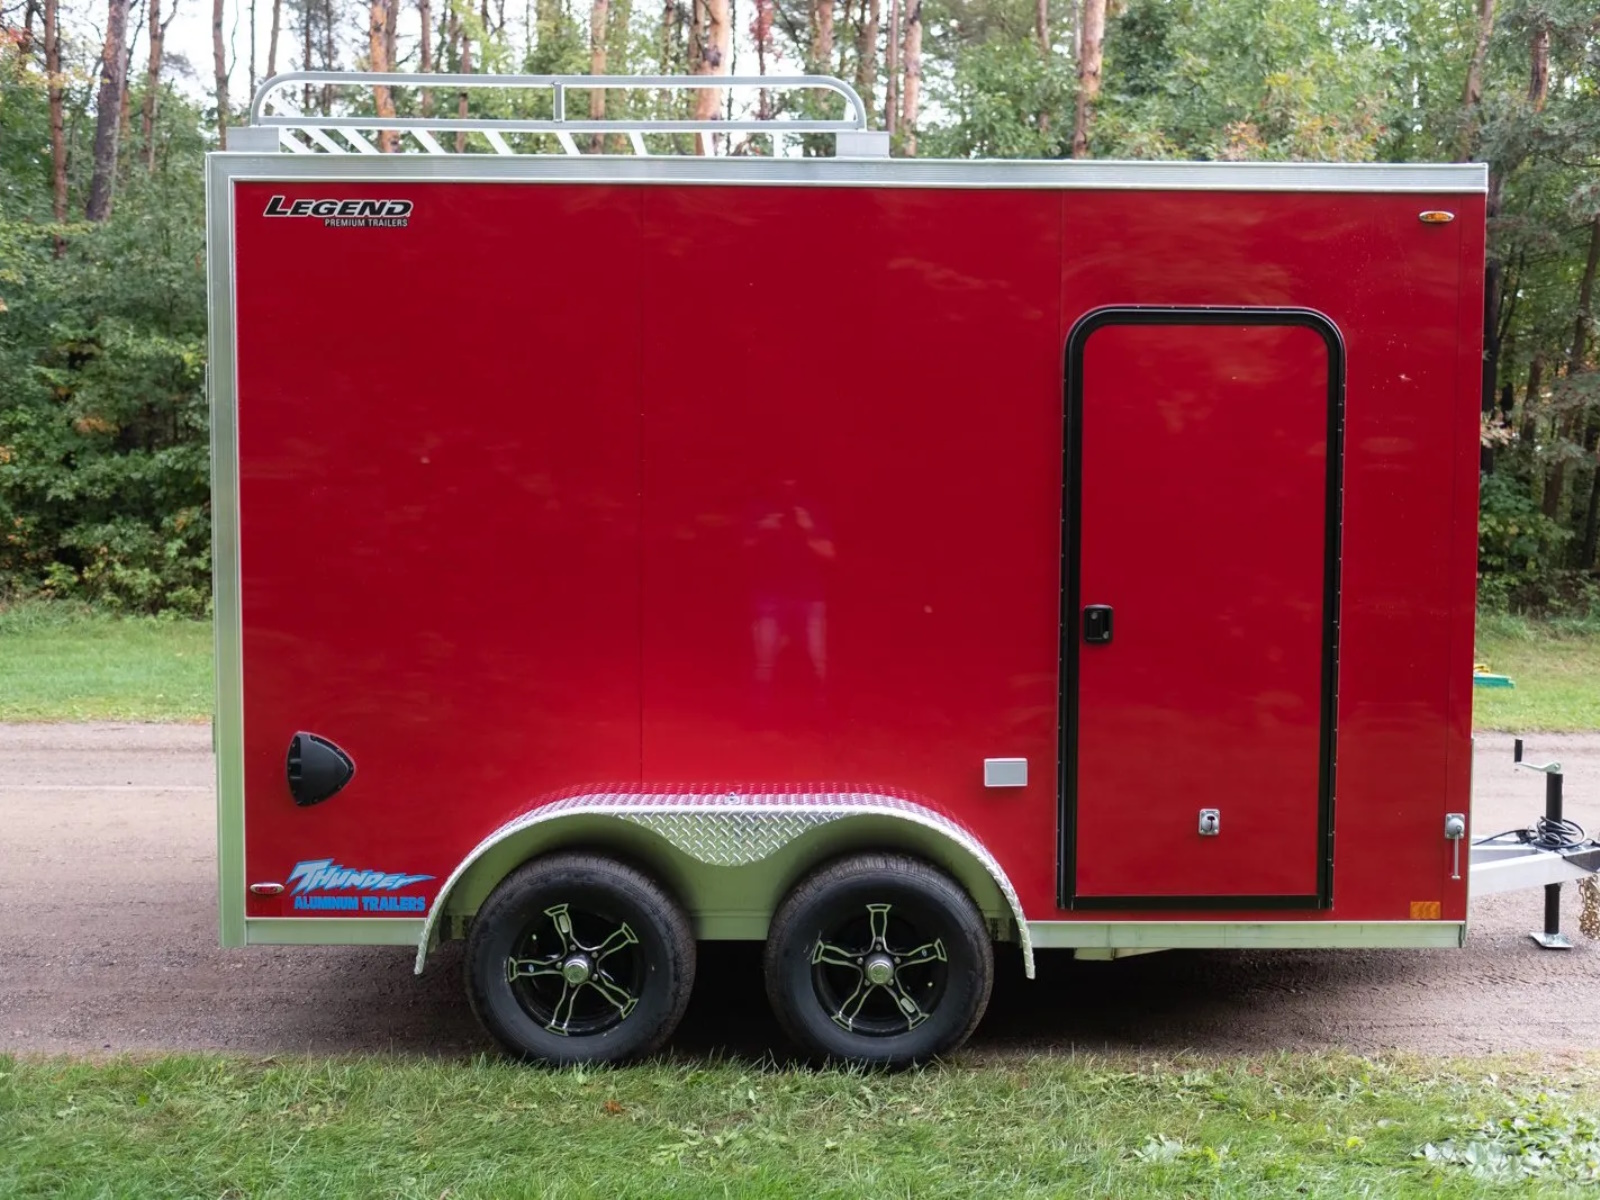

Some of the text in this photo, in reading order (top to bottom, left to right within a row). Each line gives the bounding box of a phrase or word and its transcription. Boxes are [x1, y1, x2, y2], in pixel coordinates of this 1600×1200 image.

[263, 195, 414, 218] LEGEND
[324, 218, 408, 228] PREMIUM TRAILERS
[286, 858, 437, 896] THUNDER
[294, 896, 426, 912] ALUMINUM TRAILERS
